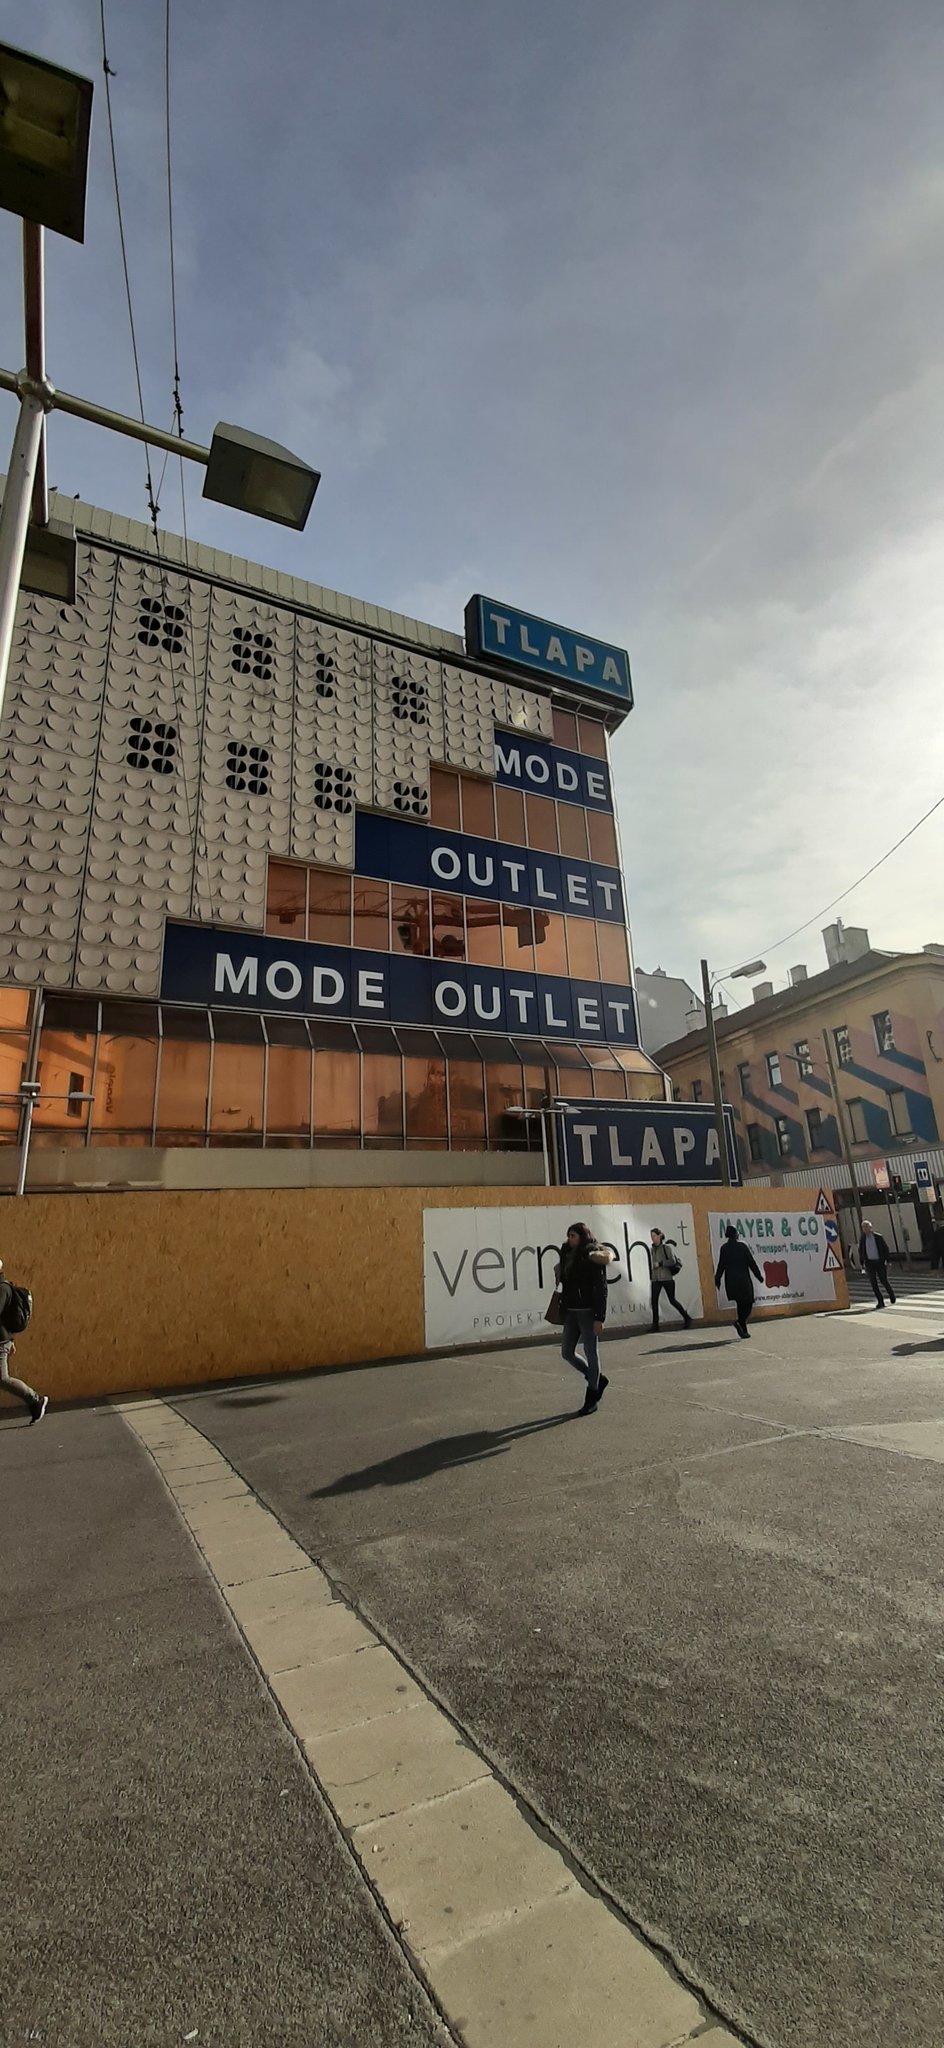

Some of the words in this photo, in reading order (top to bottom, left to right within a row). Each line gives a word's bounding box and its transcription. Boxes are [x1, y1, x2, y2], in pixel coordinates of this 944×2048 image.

[490, 613, 623, 686] TLAPA
[496, 744, 607, 801] MODE
[430, 846, 618, 911] OUTLET
[214, 952, 386, 1009] MODE
[434, 980, 630, 1034] OUTLET
[573, 1124, 721, 1166] TLAPA
[719, 1217, 775, 1239] MAYER
[781, 1216, 792, 1237] &
[798, 1216, 819, 1237] CO
